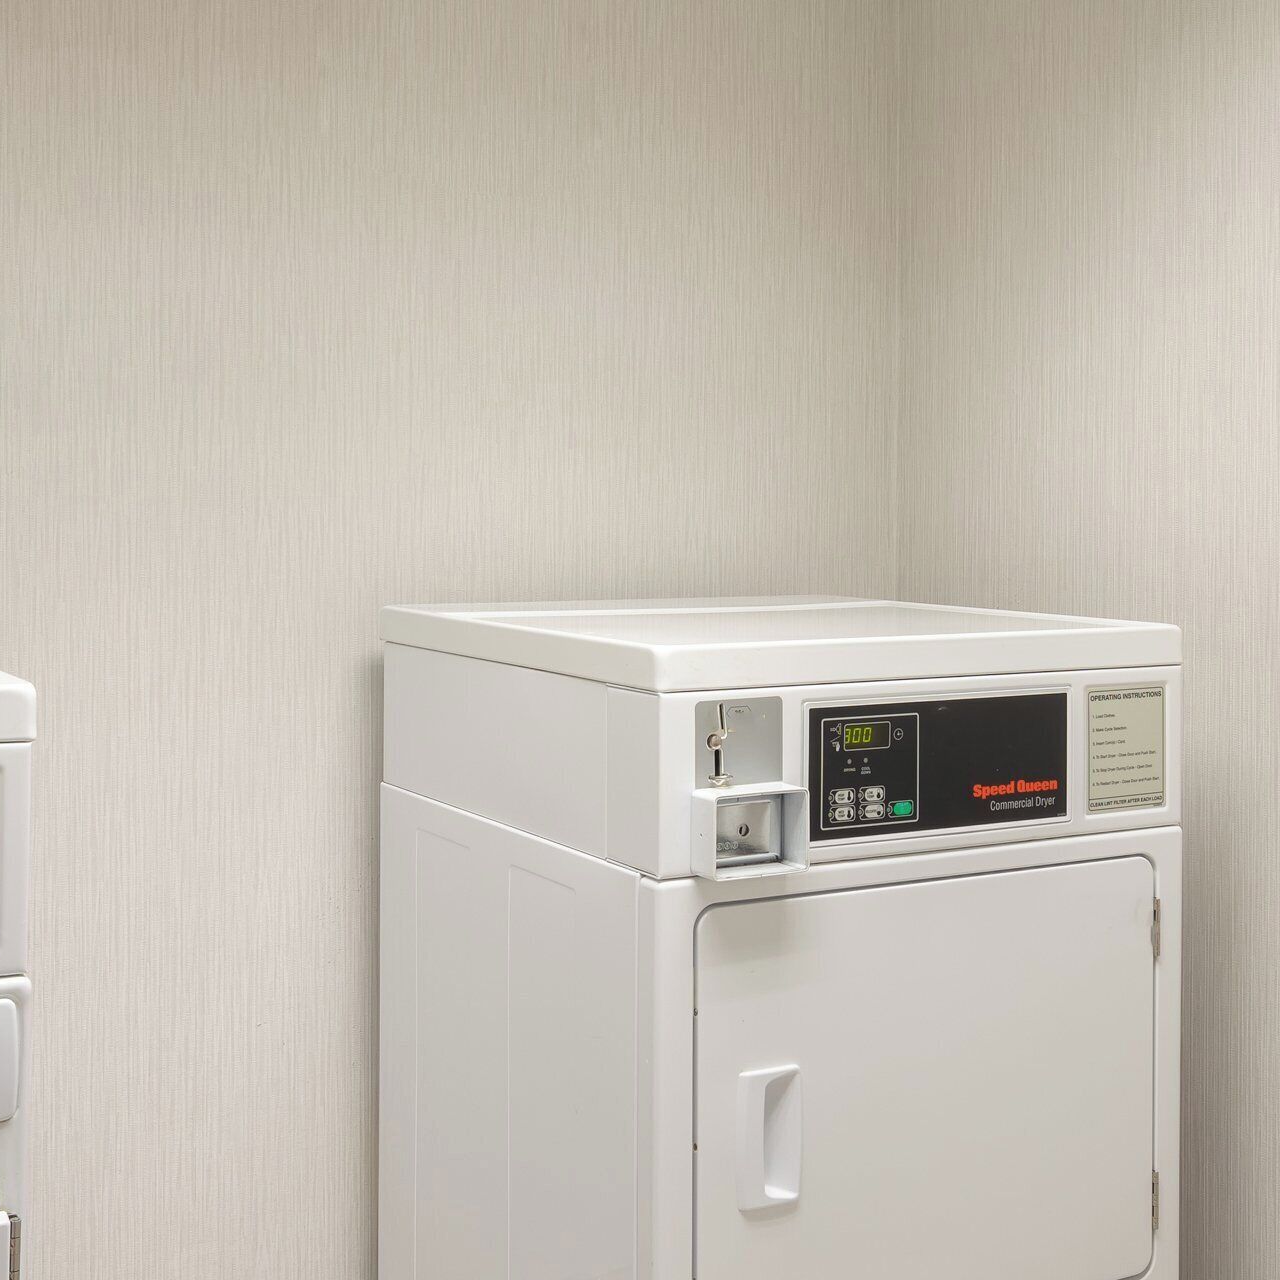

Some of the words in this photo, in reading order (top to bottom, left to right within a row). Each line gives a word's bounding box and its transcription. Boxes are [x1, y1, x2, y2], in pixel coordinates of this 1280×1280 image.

[1123, 691, 1161, 699] INSTRUCTIONS
[845, 727, 872, 743] 300
[973, 780, 1015, 799] Speed
[1017, 779, 1058, 792] Queen
[990, 797, 1033, 811] Commercial
[1035, 796, 1055, 808] Dryer
